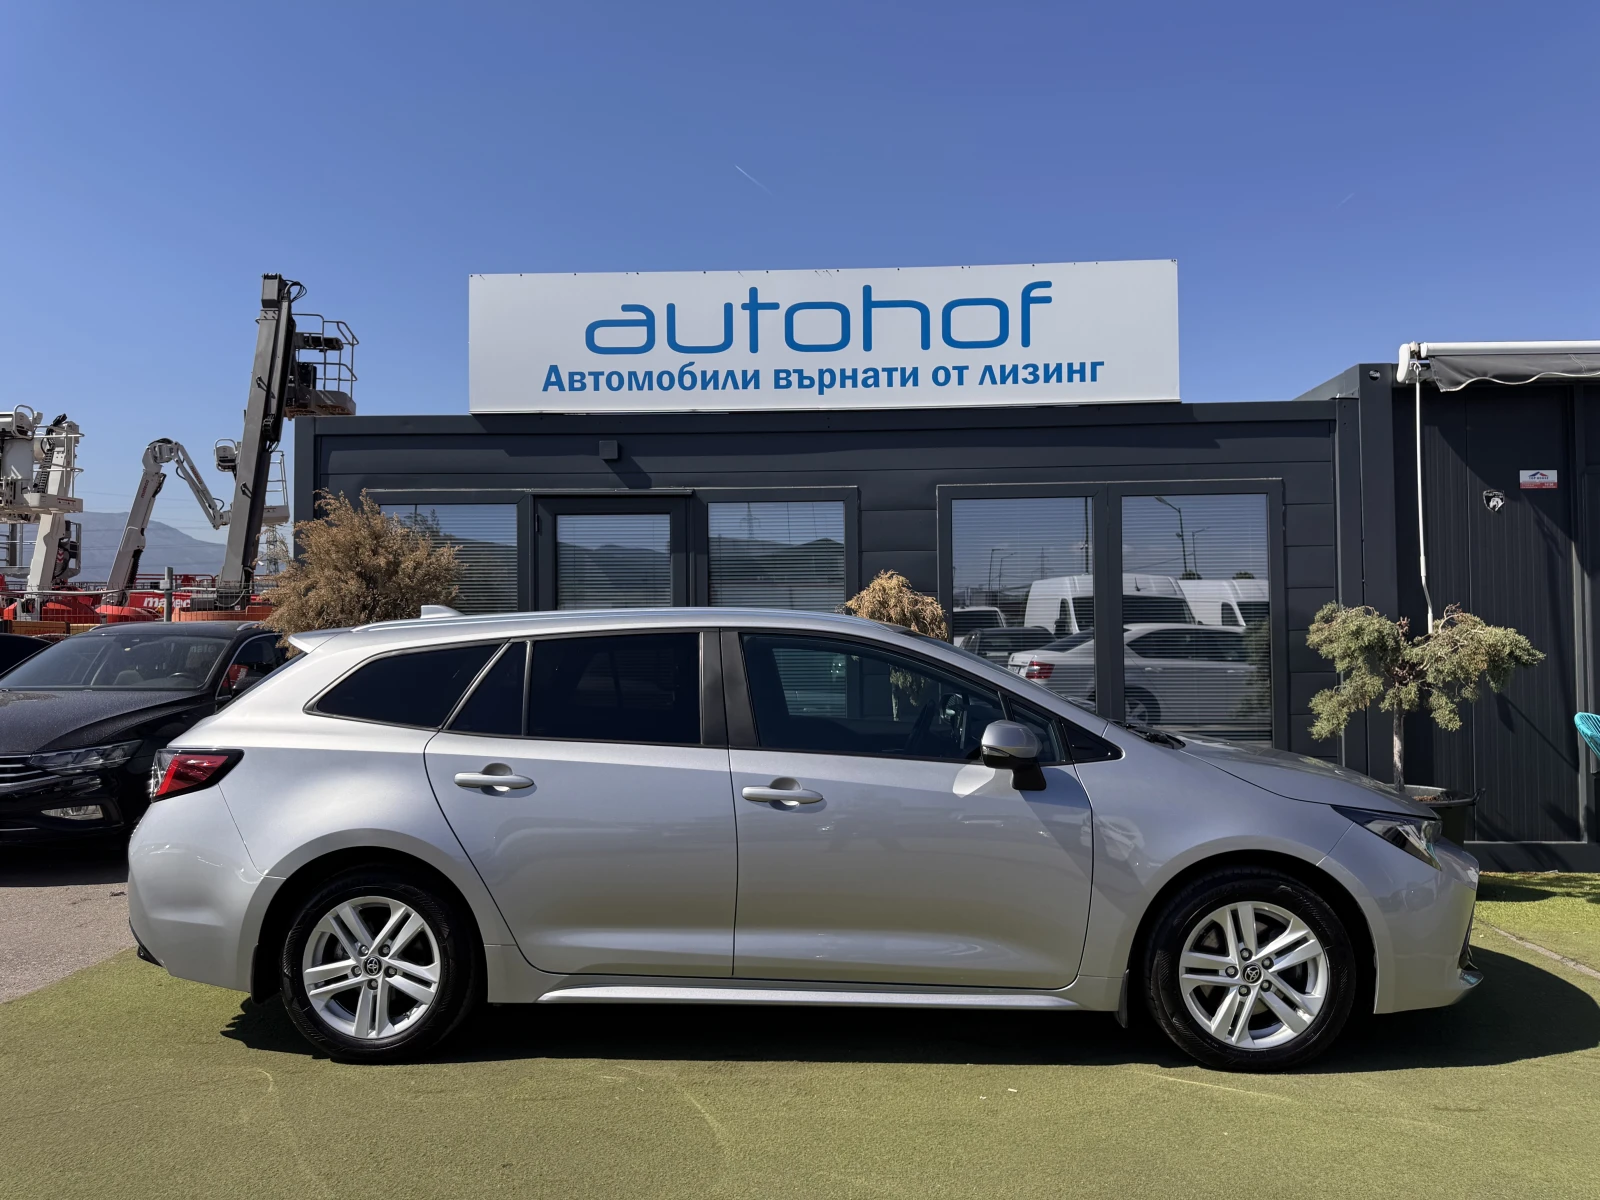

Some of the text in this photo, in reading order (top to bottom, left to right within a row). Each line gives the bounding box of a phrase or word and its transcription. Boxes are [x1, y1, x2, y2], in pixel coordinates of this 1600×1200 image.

[586, 280, 1053, 355] autohof
[542, 361, 1105, 396] Автомобили върнати от лизинг
